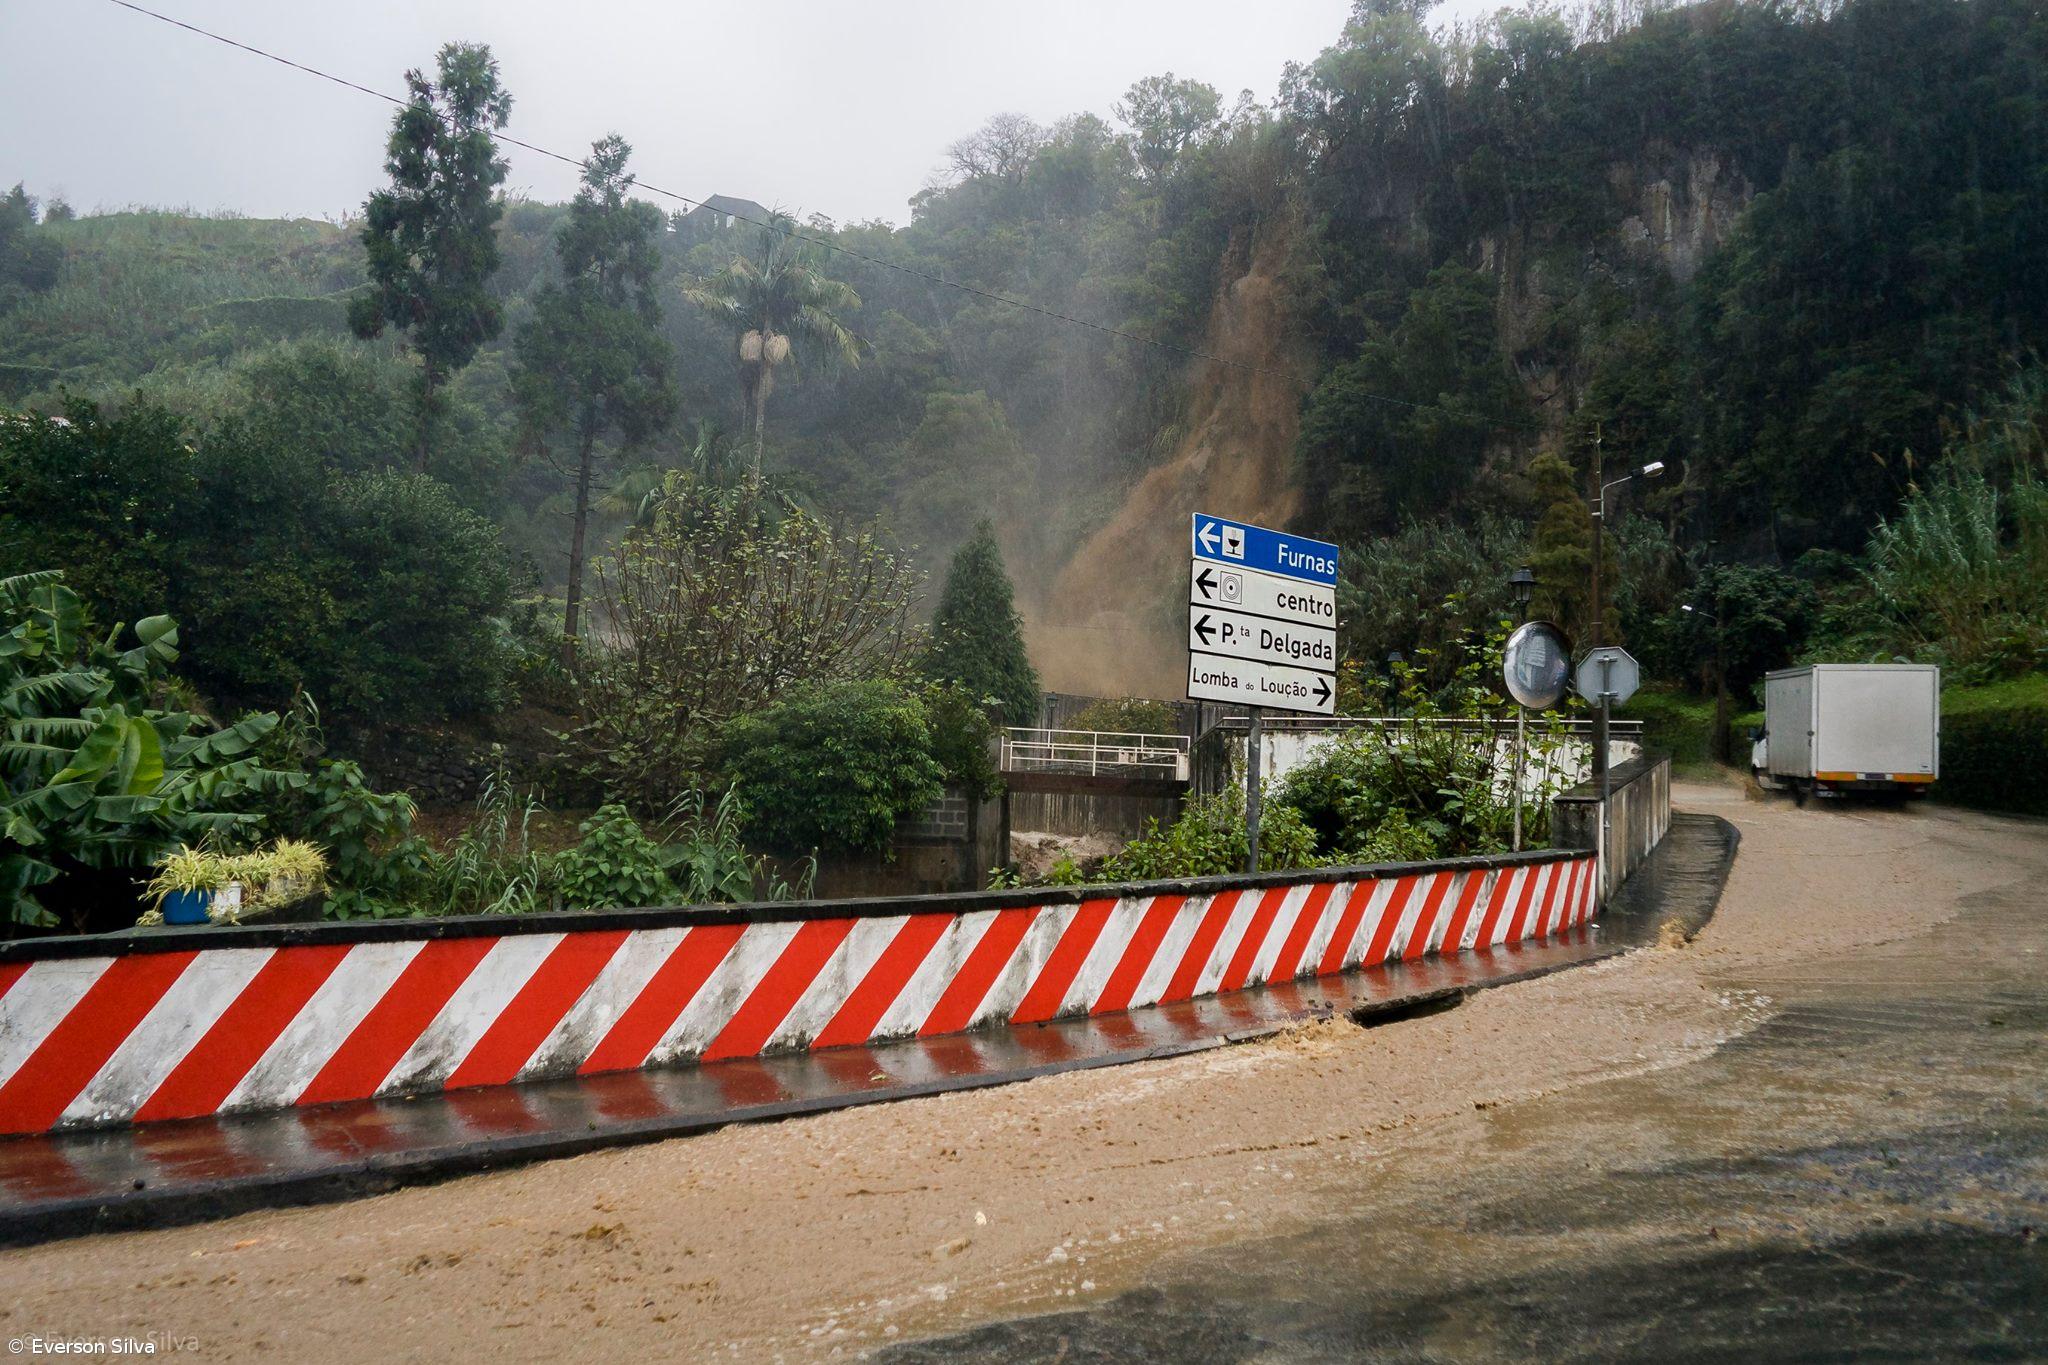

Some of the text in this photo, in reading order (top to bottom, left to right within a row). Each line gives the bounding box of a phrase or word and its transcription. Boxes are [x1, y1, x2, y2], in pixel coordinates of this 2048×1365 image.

[1278, 543, 1335, 575] Furnas
[1276, 593, 1333, 617] centro
[1260, 629, 1333, 661] Delgada
[1192, 667, 1308, 698] Lomba do Loução
